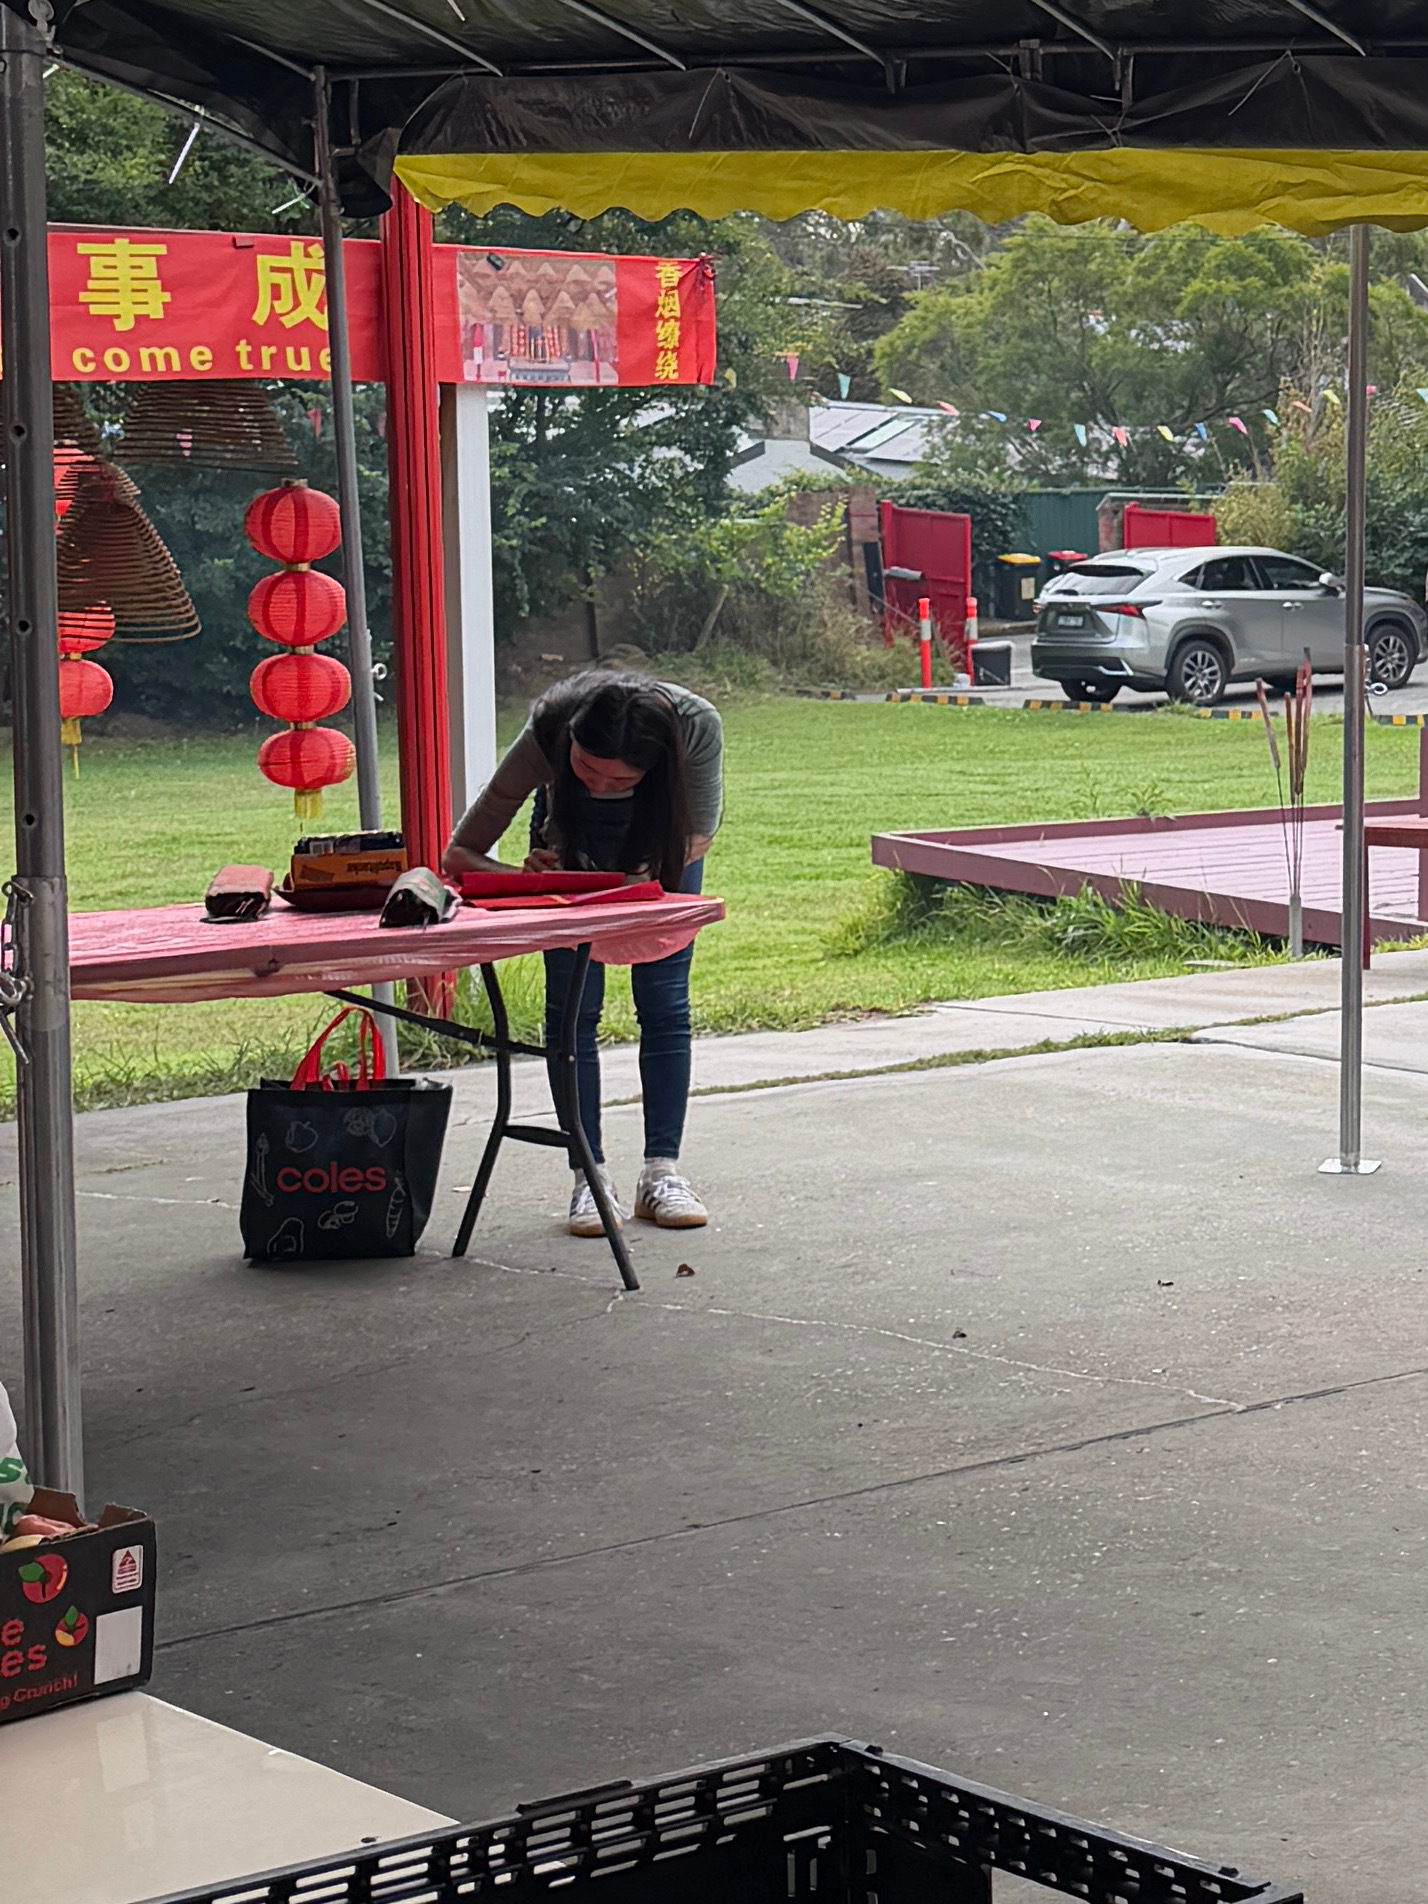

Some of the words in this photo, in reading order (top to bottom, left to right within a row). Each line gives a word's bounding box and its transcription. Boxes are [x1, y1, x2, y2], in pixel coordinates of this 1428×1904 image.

[77, 238, 329, 332] 事成
[72, 345, 213, 373] come
[275, 1160, 387, 1194] coles
[13, 1672, 78, 1705] Crunch!
